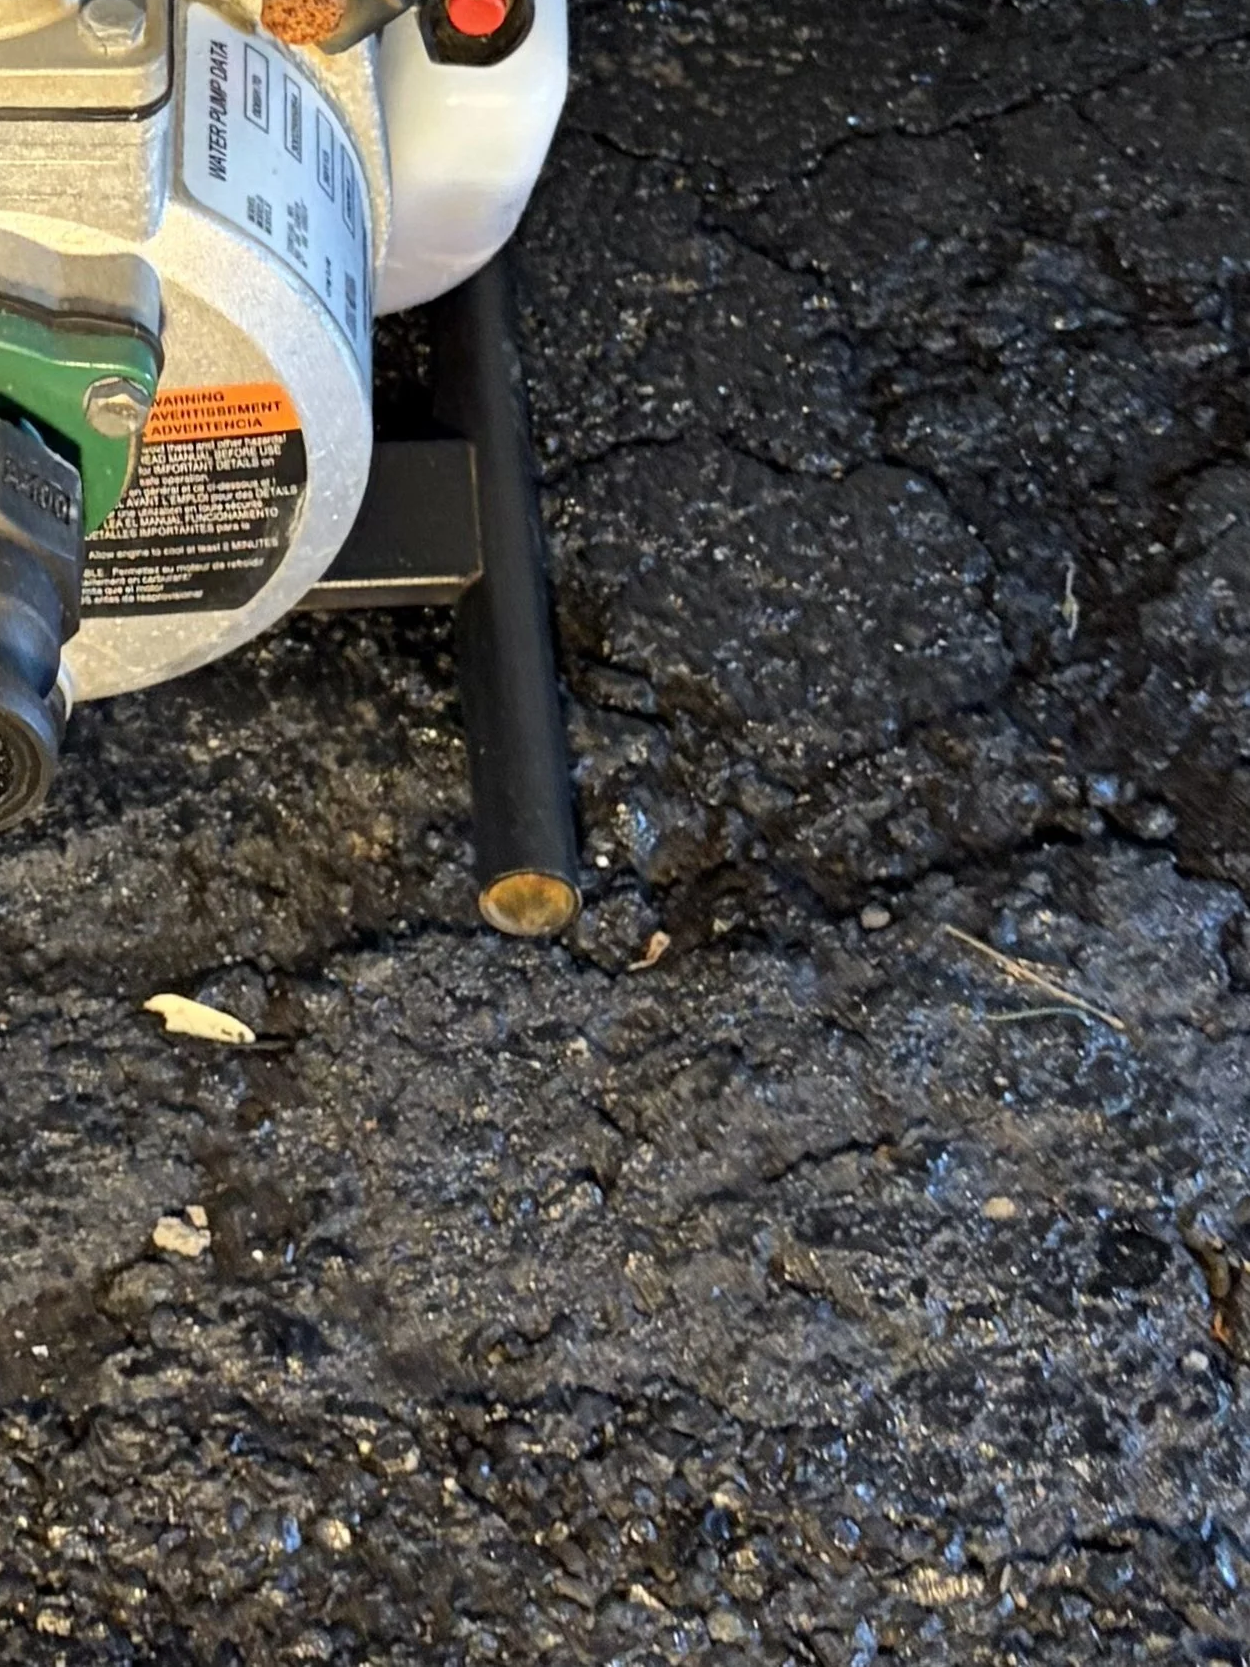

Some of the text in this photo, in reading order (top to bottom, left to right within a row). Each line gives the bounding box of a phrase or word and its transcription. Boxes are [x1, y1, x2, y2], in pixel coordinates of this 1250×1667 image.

[208, 39, 228, 182] WATER PUMP DATA
[150, 401, 282, 422] AVERTISSEMENT
[151, 417, 263, 437] ADVERTENCIA
[166, 443, 194, 453] these
[196, 440, 215, 451] and
[216, 438, 242, 449] other
[168, 450, 211, 462] MANUAL
[214, 447, 258, 459] BEFORE
[259, 445, 282, 455] USE
[153, 459, 213, 474] IMPORTANT
[216, 457, 259, 471] DETAILS
[126, 496, 158, 507] AVANT
[140, 515, 183, 528] MANUAL
[139, 524, 214, 538] IMPORTANTES
[151, 548, 161, 557] to
[163, 546, 184, 556] cool
